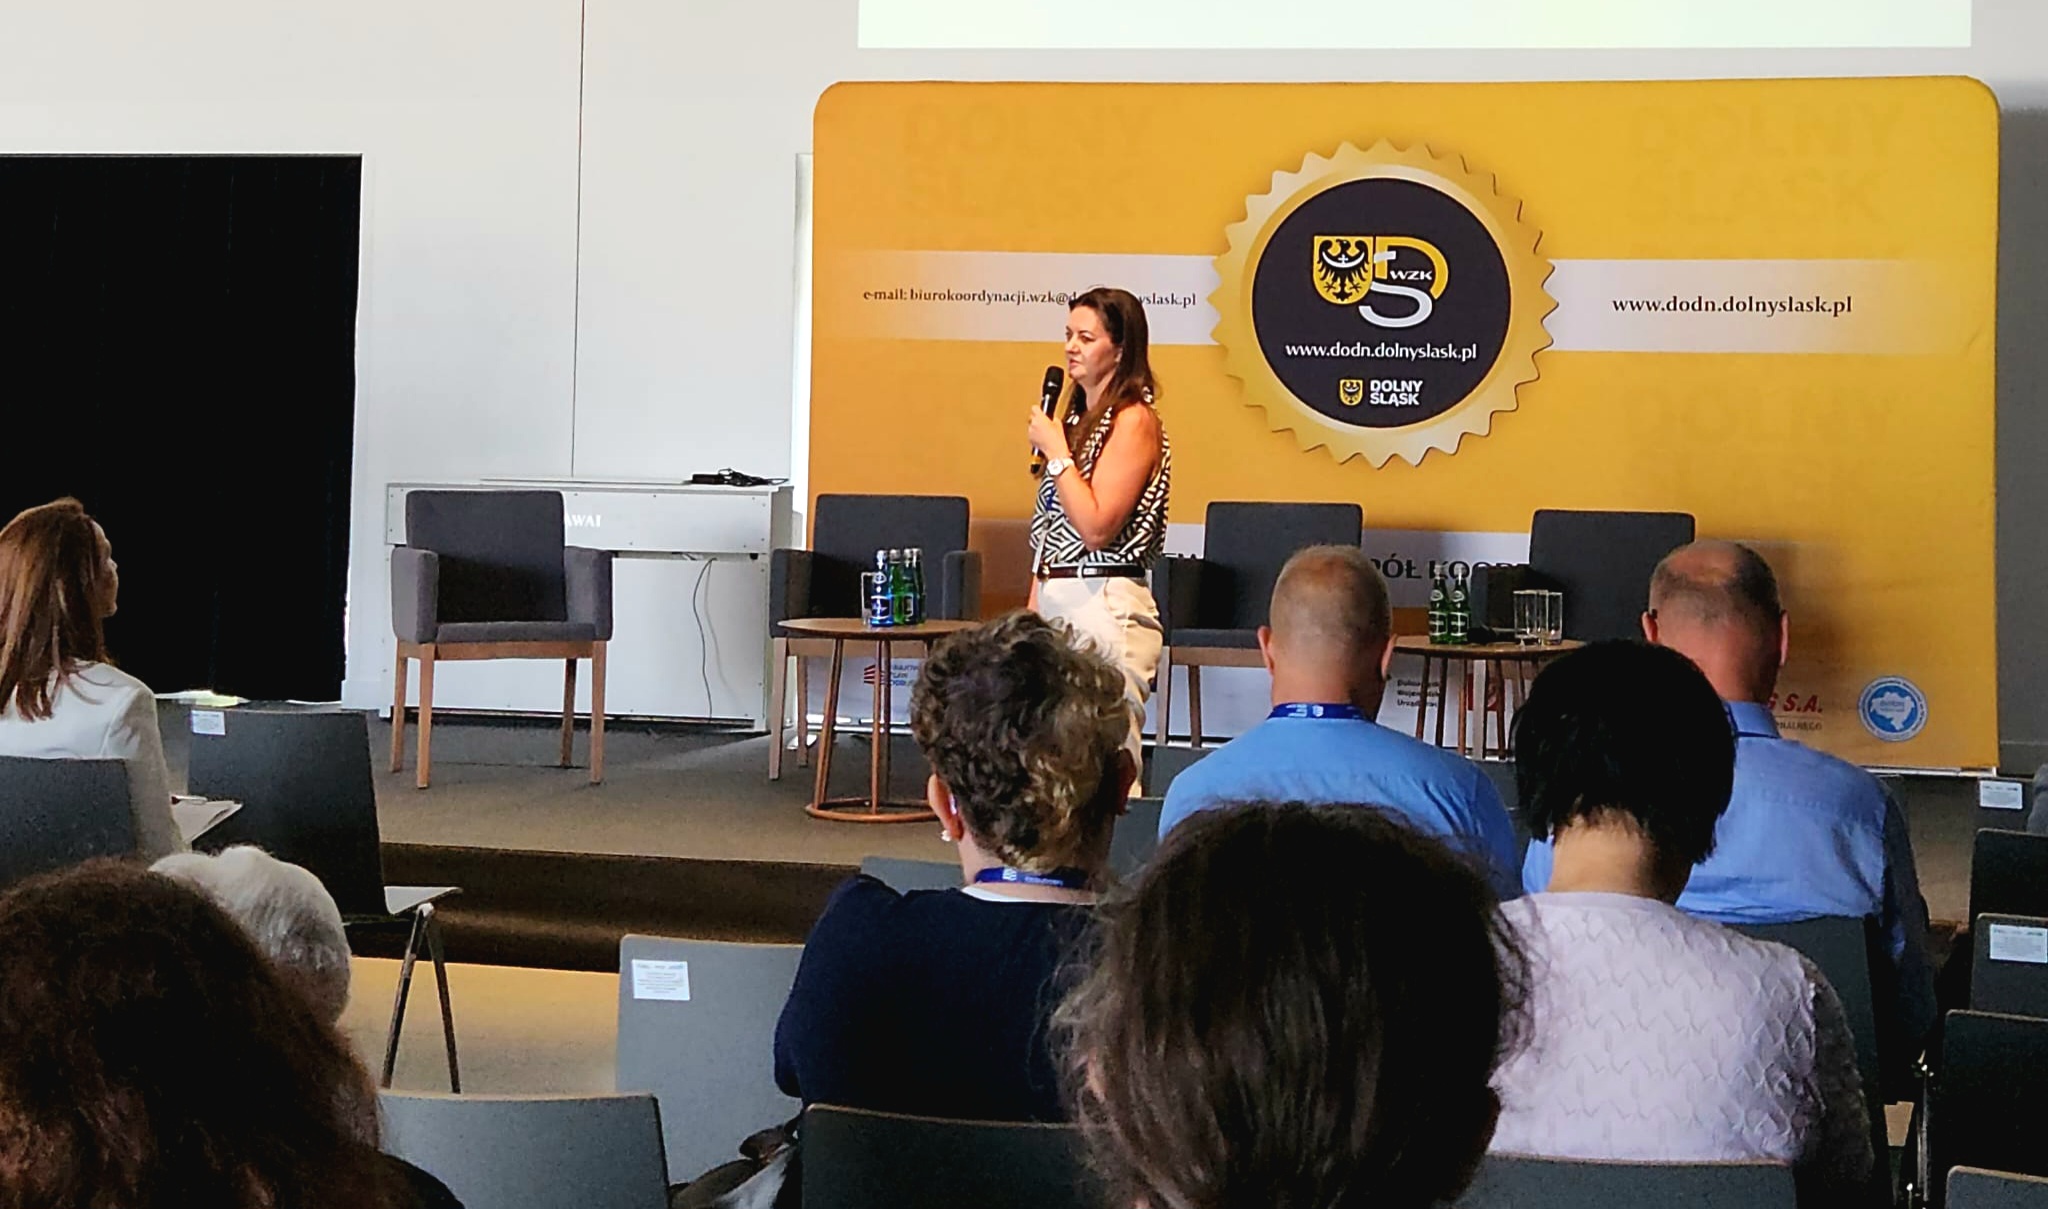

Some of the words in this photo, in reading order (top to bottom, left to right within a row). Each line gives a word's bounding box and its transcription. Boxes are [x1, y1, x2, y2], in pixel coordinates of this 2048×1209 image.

[1390, 270, 1432, 280] WZK
[863, 287, 907, 301] e-mail:
[1612, 296, 1852, 317] www.dodn.dolnyslask.pl
[1286, 341, 1477, 361] www.dodn.dolnyslask.pl
[1370, 379, 1423, 392] DOLNY
